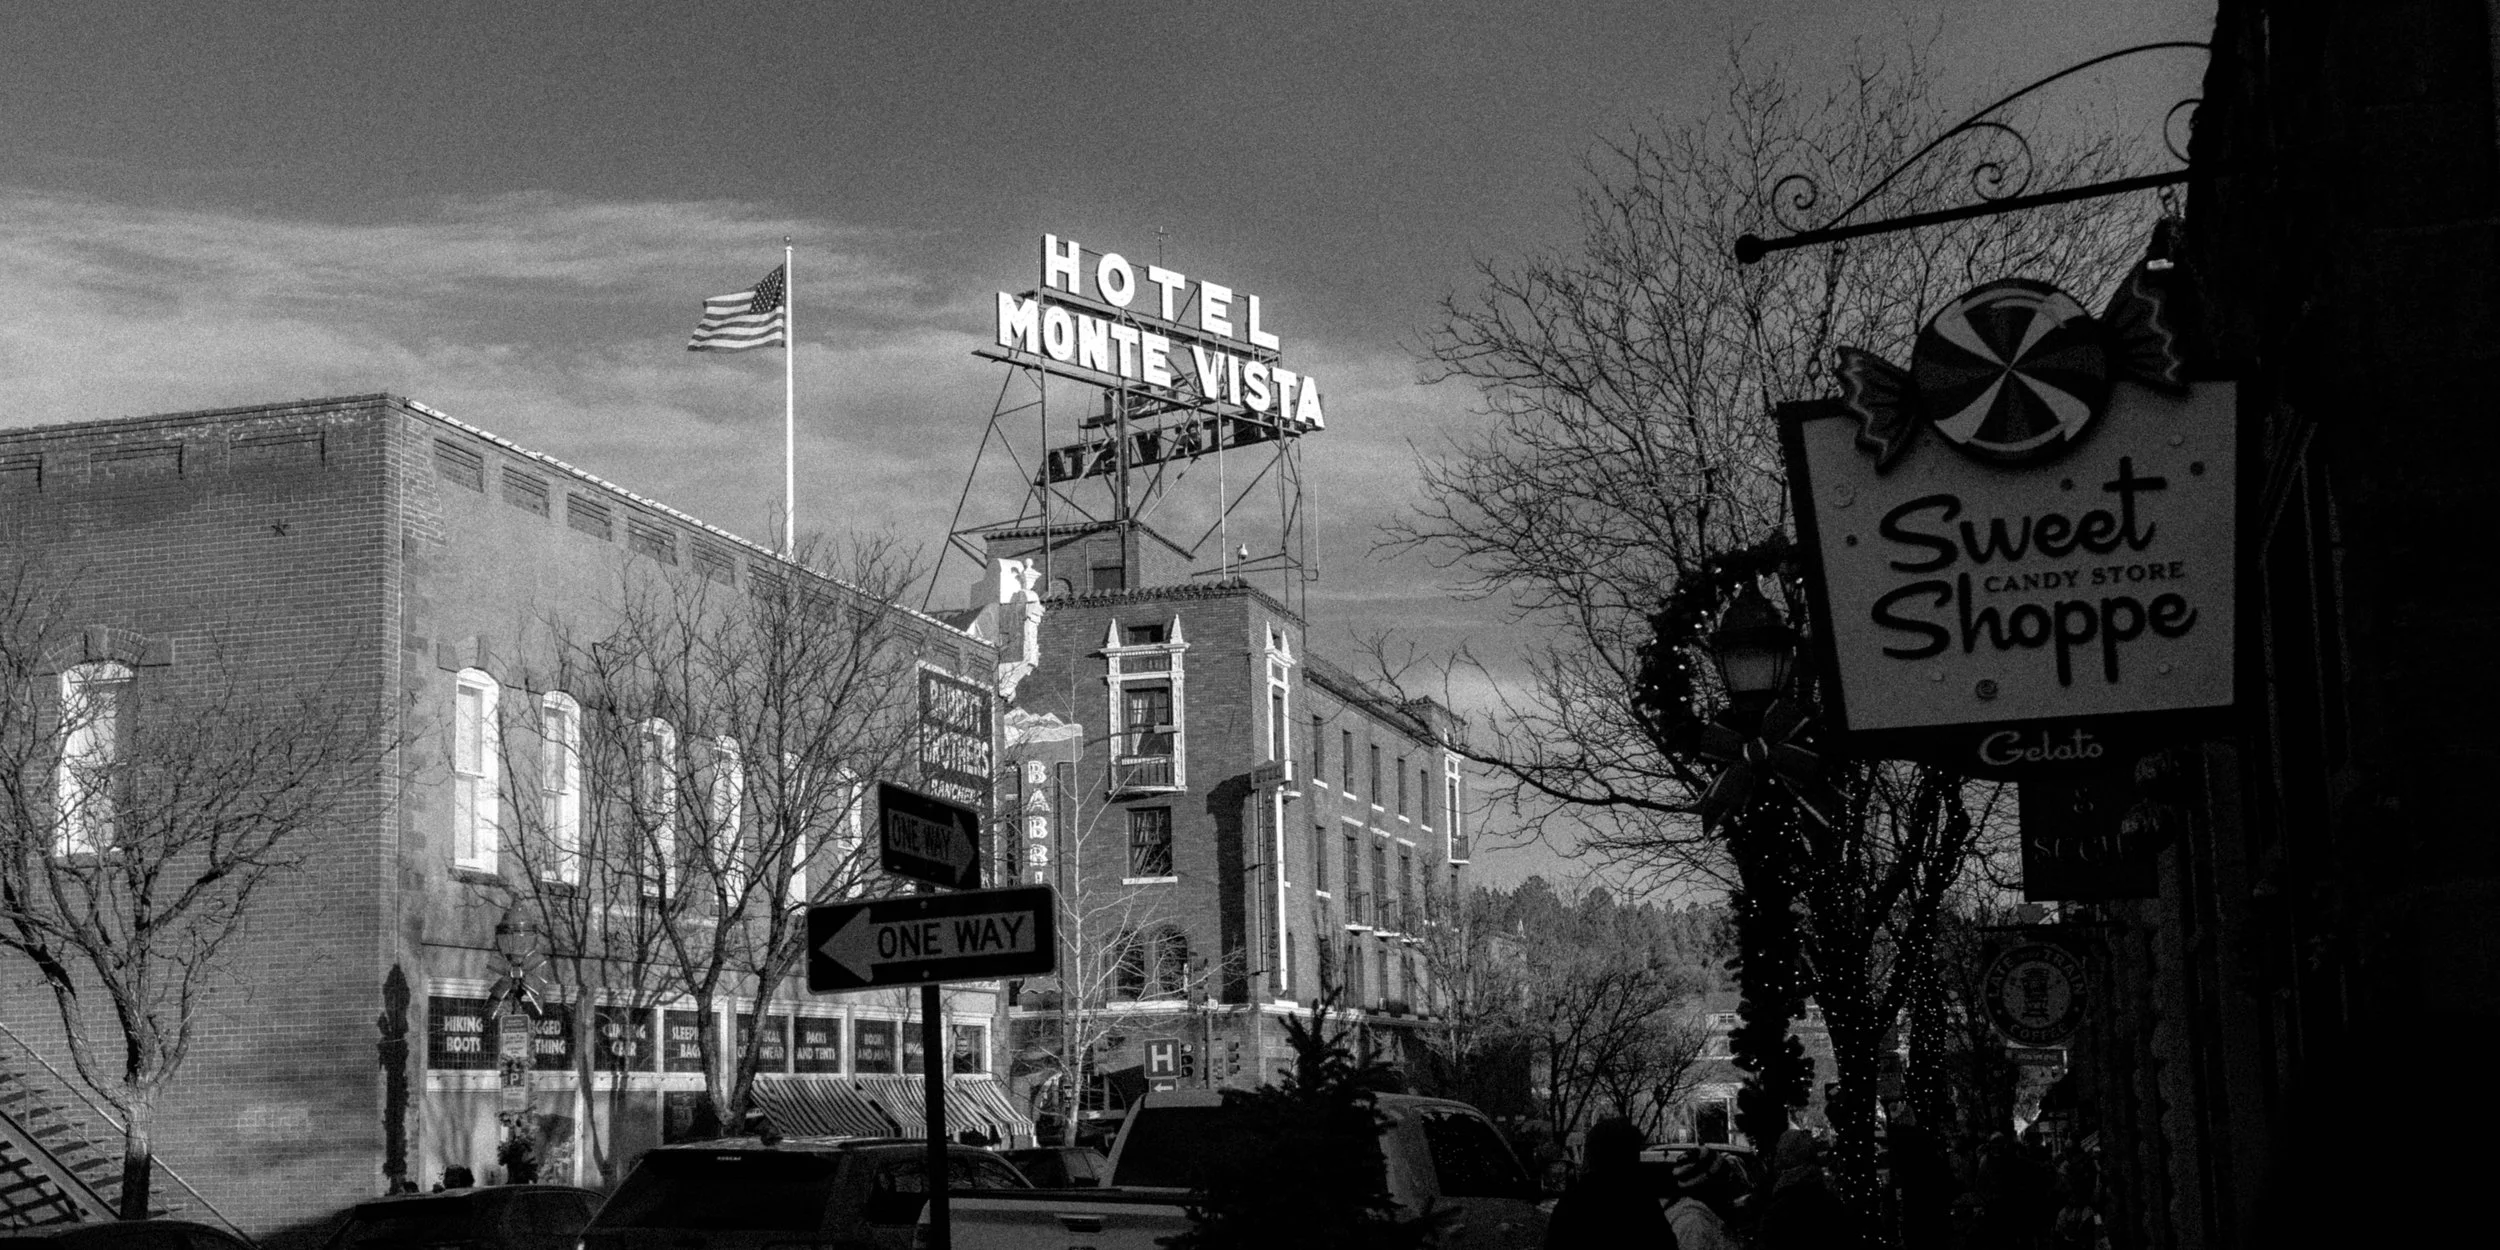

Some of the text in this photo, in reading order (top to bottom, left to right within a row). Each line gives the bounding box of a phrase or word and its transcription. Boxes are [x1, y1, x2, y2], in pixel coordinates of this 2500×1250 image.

[1043, 233, 1280, 351] HOTEL
[997, 291, 1325, 430] MONTE VISTA
[1878, 456, 2168, 574] Sweet
[1983, 561, 2185, 594] CANDY STORE
[1870, 572, 2198, 688] Shoppe
[1978, 728, 2104, 766] Gelato
[892, 814, 952, 861] ONE WAY
[877, 915, 1024, 959] ONE WAY
[2044, 949, 2085, 994] TRAIN
[444, 1015, 483, 1032] HIKING
[806, 1031, 827, 1044] PACKS
[2009, 1023, 2068, 1041] COFFEE
[446, 1036, 481, 1053] BOOTS
[797, 1046, 836, 1060] AND TENTS
[1151, 1044, 1174, 1072] H
[510, 1073, 519, 1086] P
